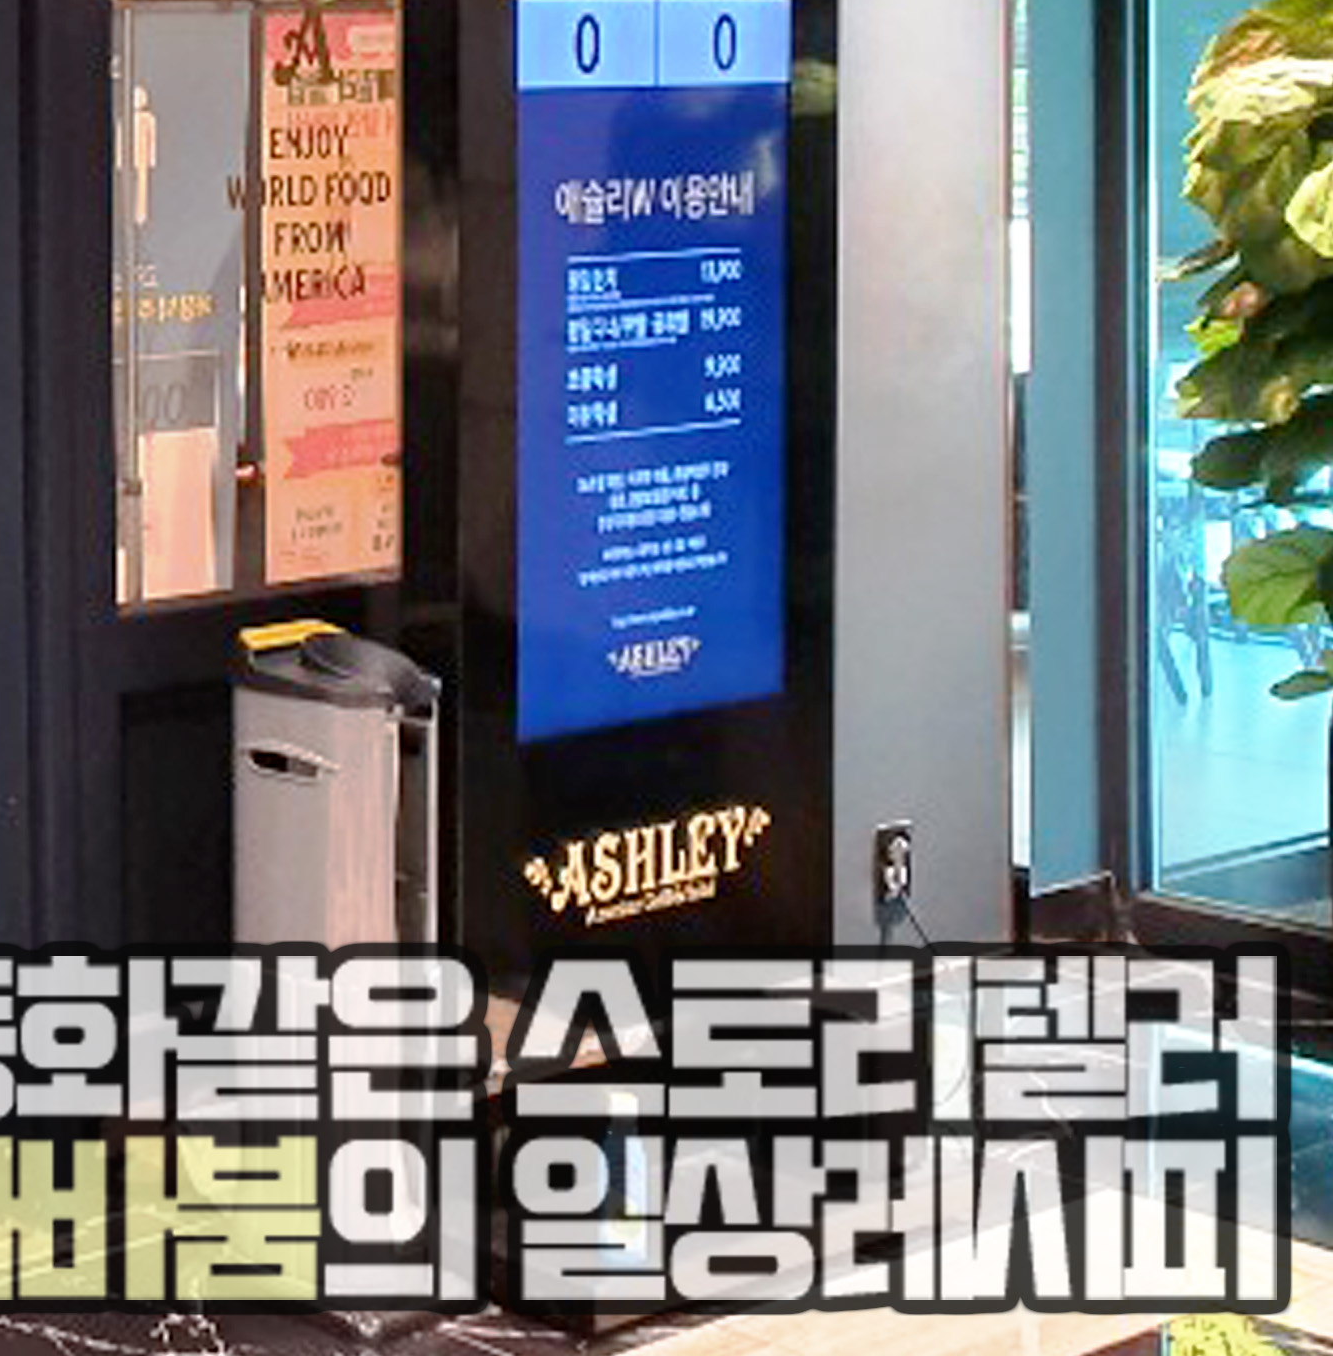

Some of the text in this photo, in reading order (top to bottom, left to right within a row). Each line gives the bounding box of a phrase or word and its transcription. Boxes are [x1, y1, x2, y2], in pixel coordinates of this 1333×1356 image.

[575, 13, 600, 74] 0
[713, 13, 737, 72] 0
[270, 124, 348, 159] ENJOY
[324, 170, 391, 207] FOOD
[660, 170, 755, 221] 이용안내
[274, 220, 345, 257] FROM
[551, 805, 747, 913] ASHLEY
